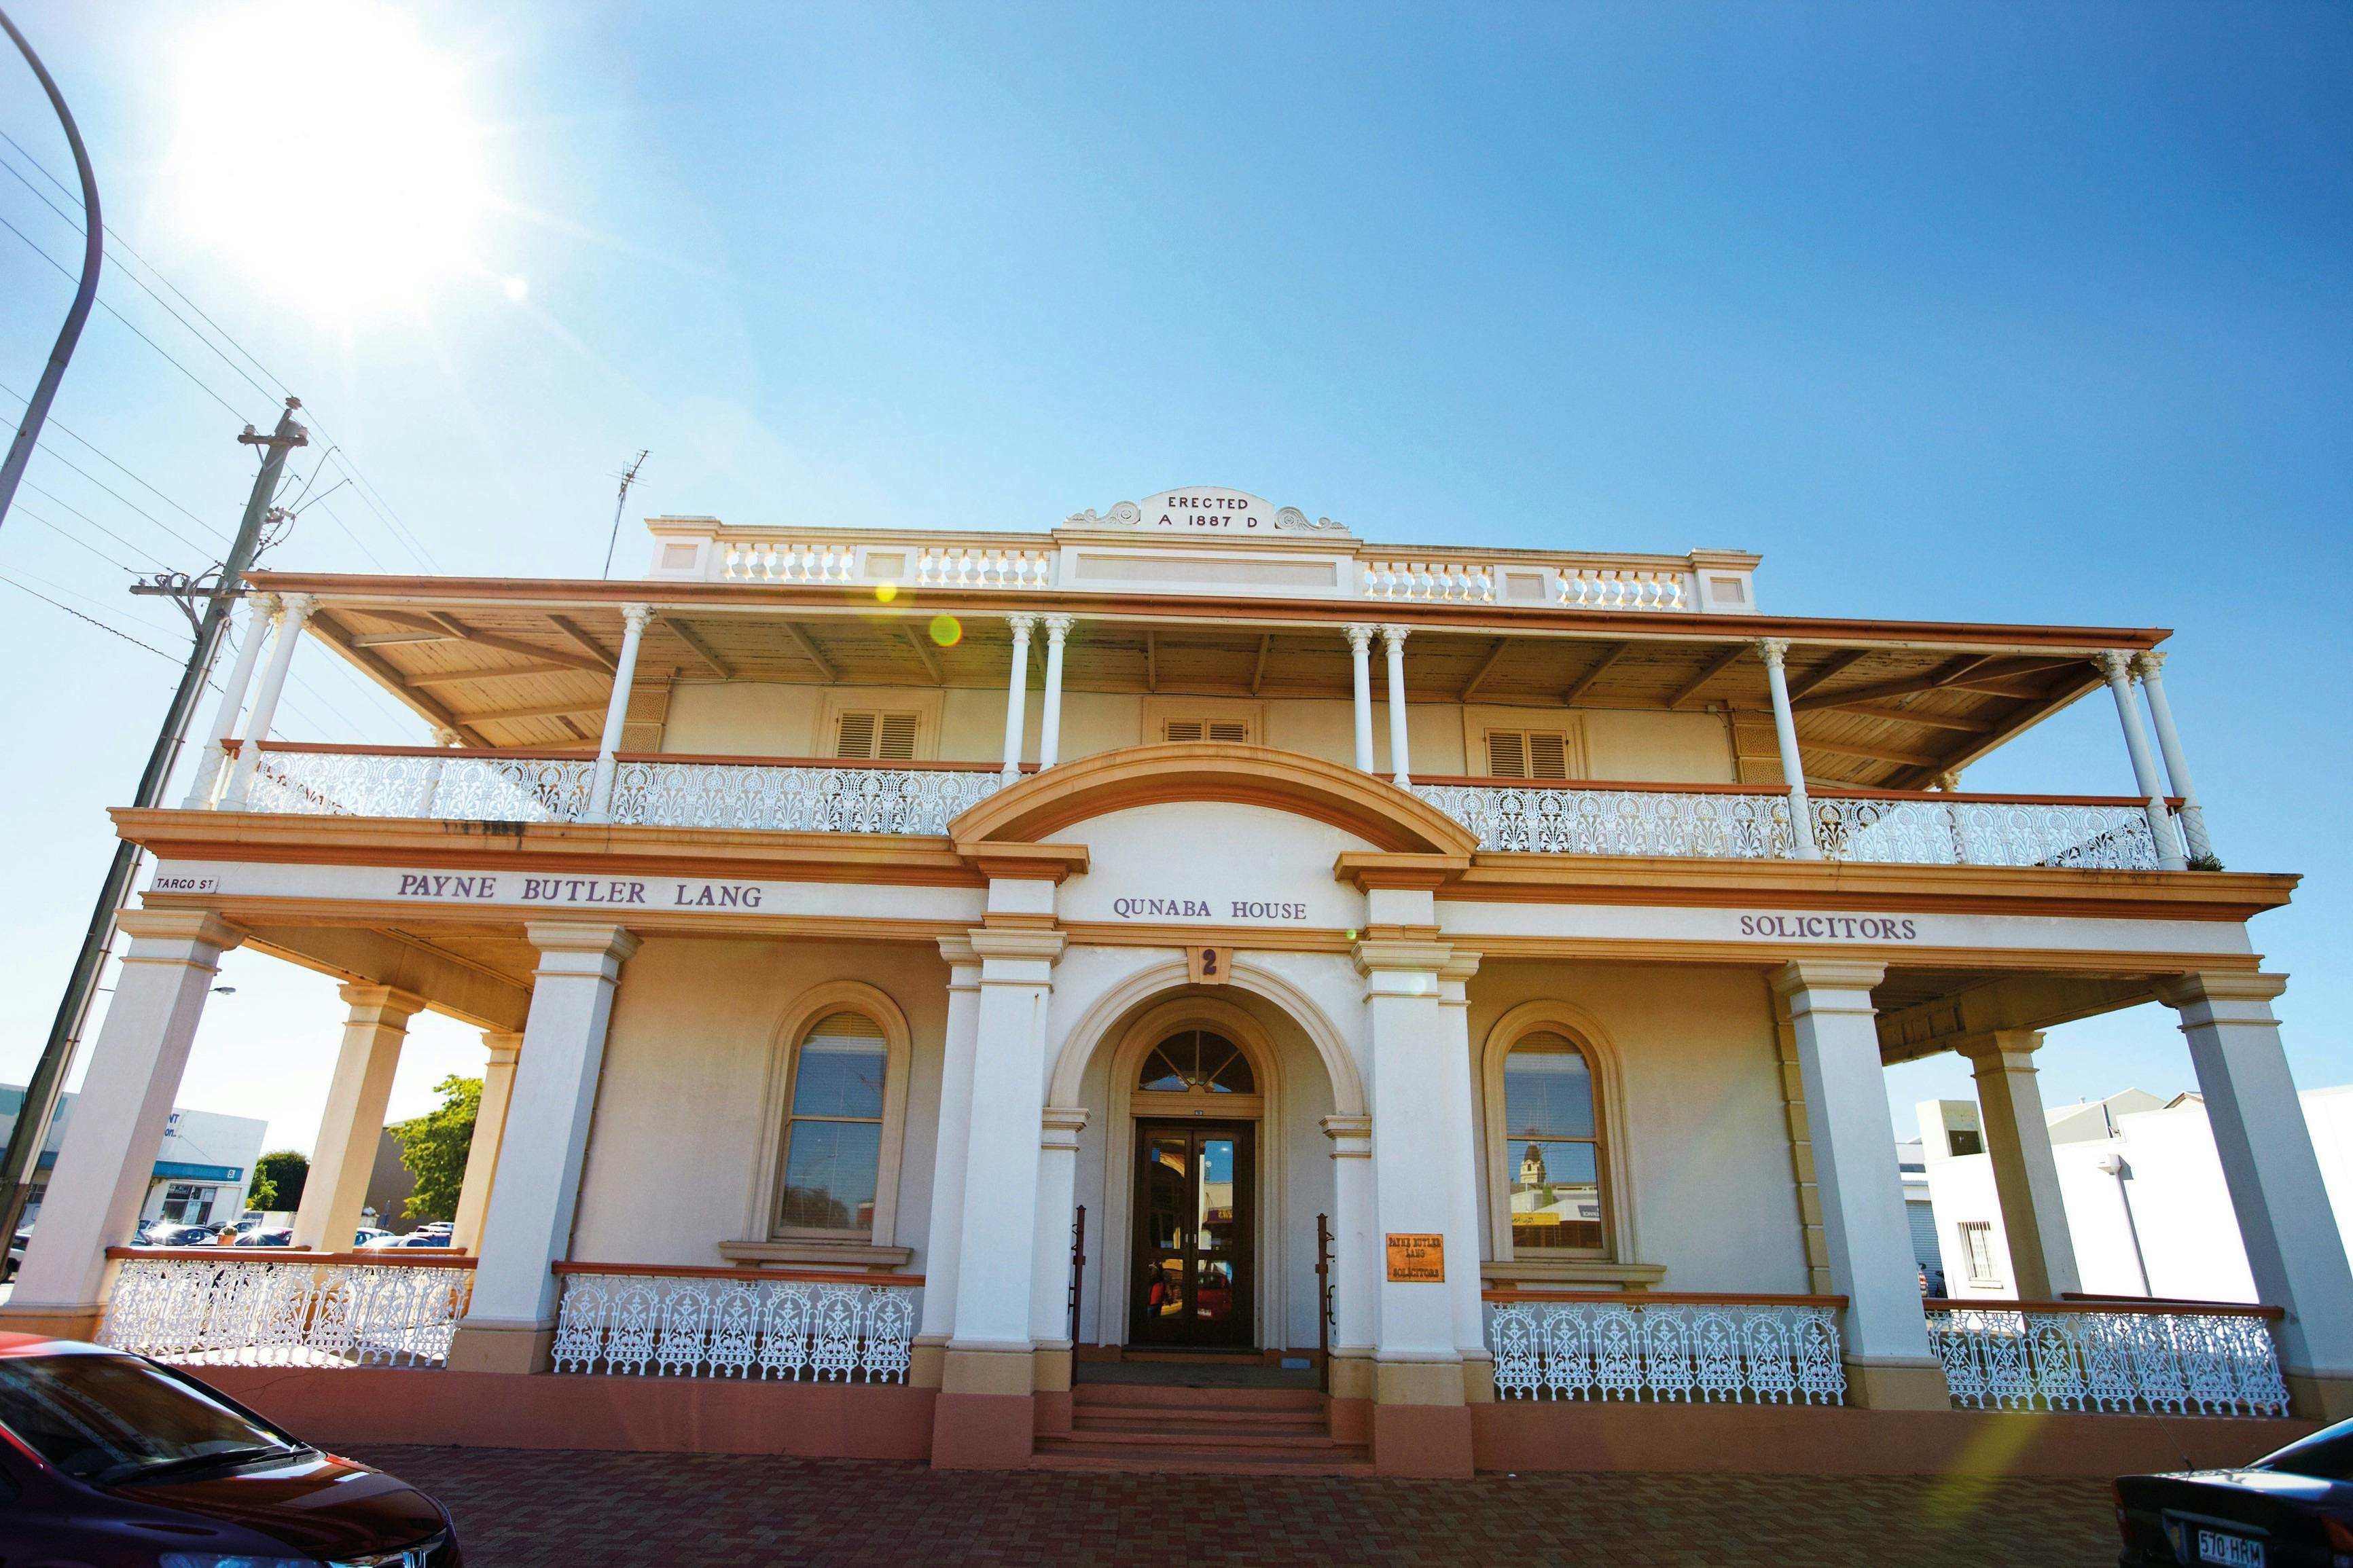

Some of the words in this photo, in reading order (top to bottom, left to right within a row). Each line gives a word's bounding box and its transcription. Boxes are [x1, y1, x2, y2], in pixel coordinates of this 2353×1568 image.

[1168, 496, 1248, 509] ERECTED
[1158, 514, 1172, 525] A
[1189, 515, 1231, 527] 1887
[1247, 517, 1257, 528] D
[157, 878, 195, 889] TARGO
[397, 874, 497, 898] PAYNE
[521, 878, 646, 904] BUTLER
[675, 884, 762, 908] LANG
[1113, 898, 1212, 918] QUNABA
[1231, 901, 1307, 919] HOUSE
[1740, 915, 1917, 940] SOLICITORS
[1202, 949, 1217, 975] 2
